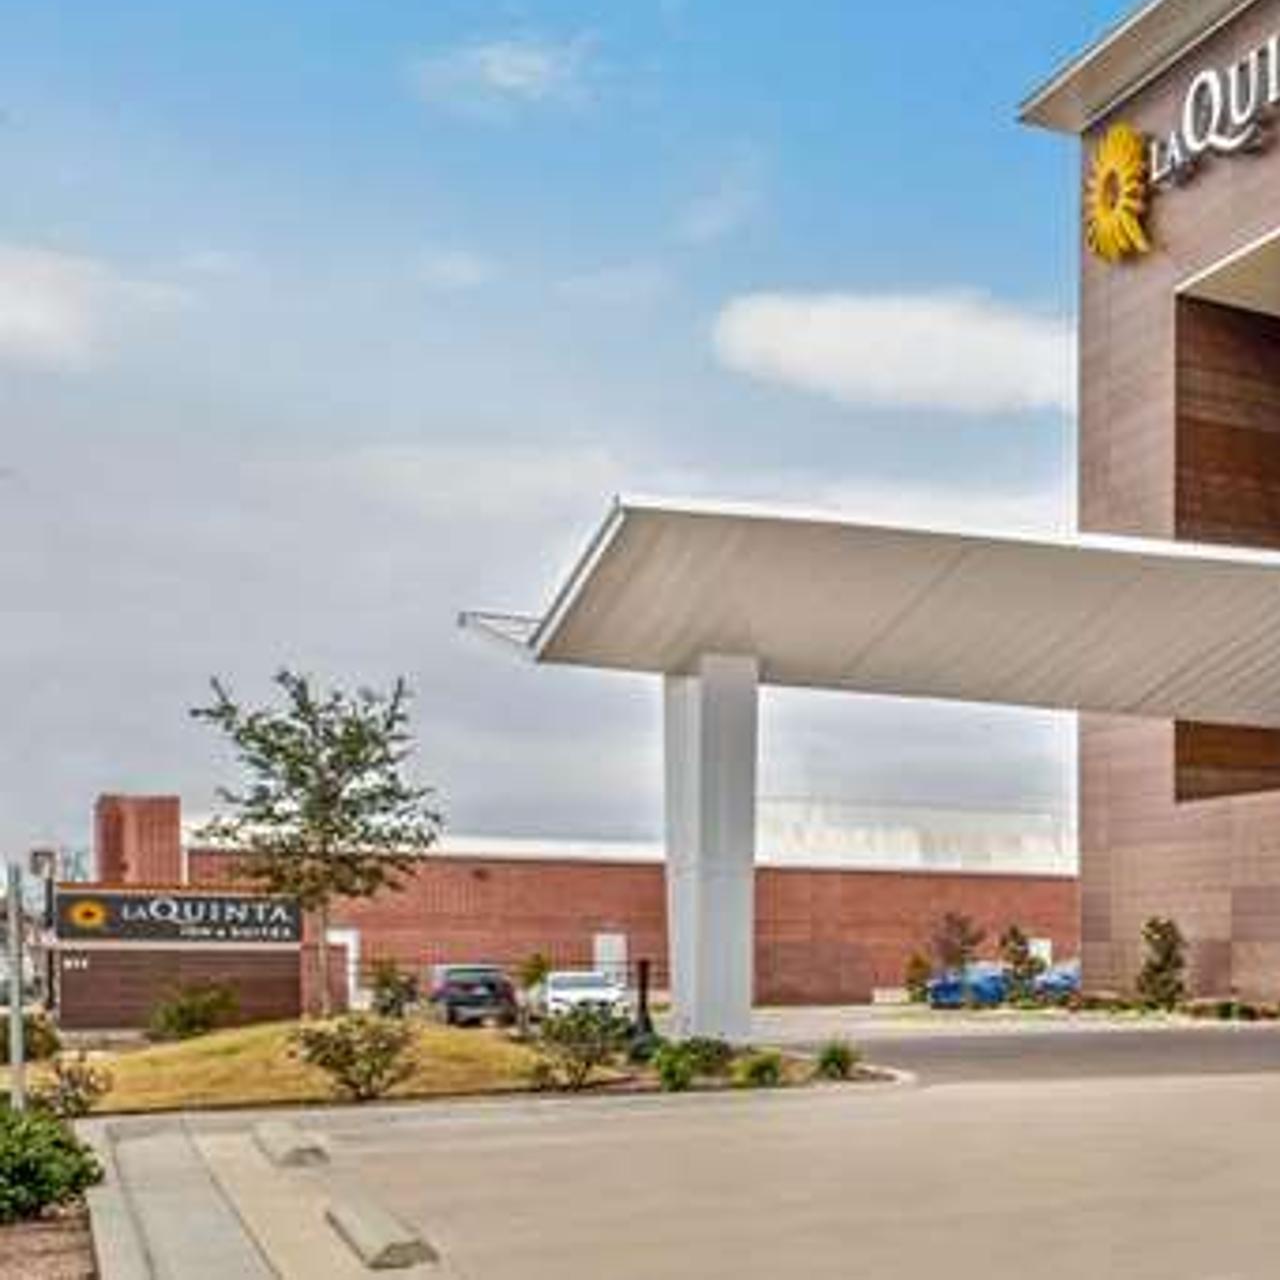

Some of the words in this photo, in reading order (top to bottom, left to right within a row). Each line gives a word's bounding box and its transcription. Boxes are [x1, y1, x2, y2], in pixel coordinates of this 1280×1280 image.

[1151, 131, 1185, 181] LA
[122, 903, 148, 920] LA
[149, 898, 292, 923] QUINTA
